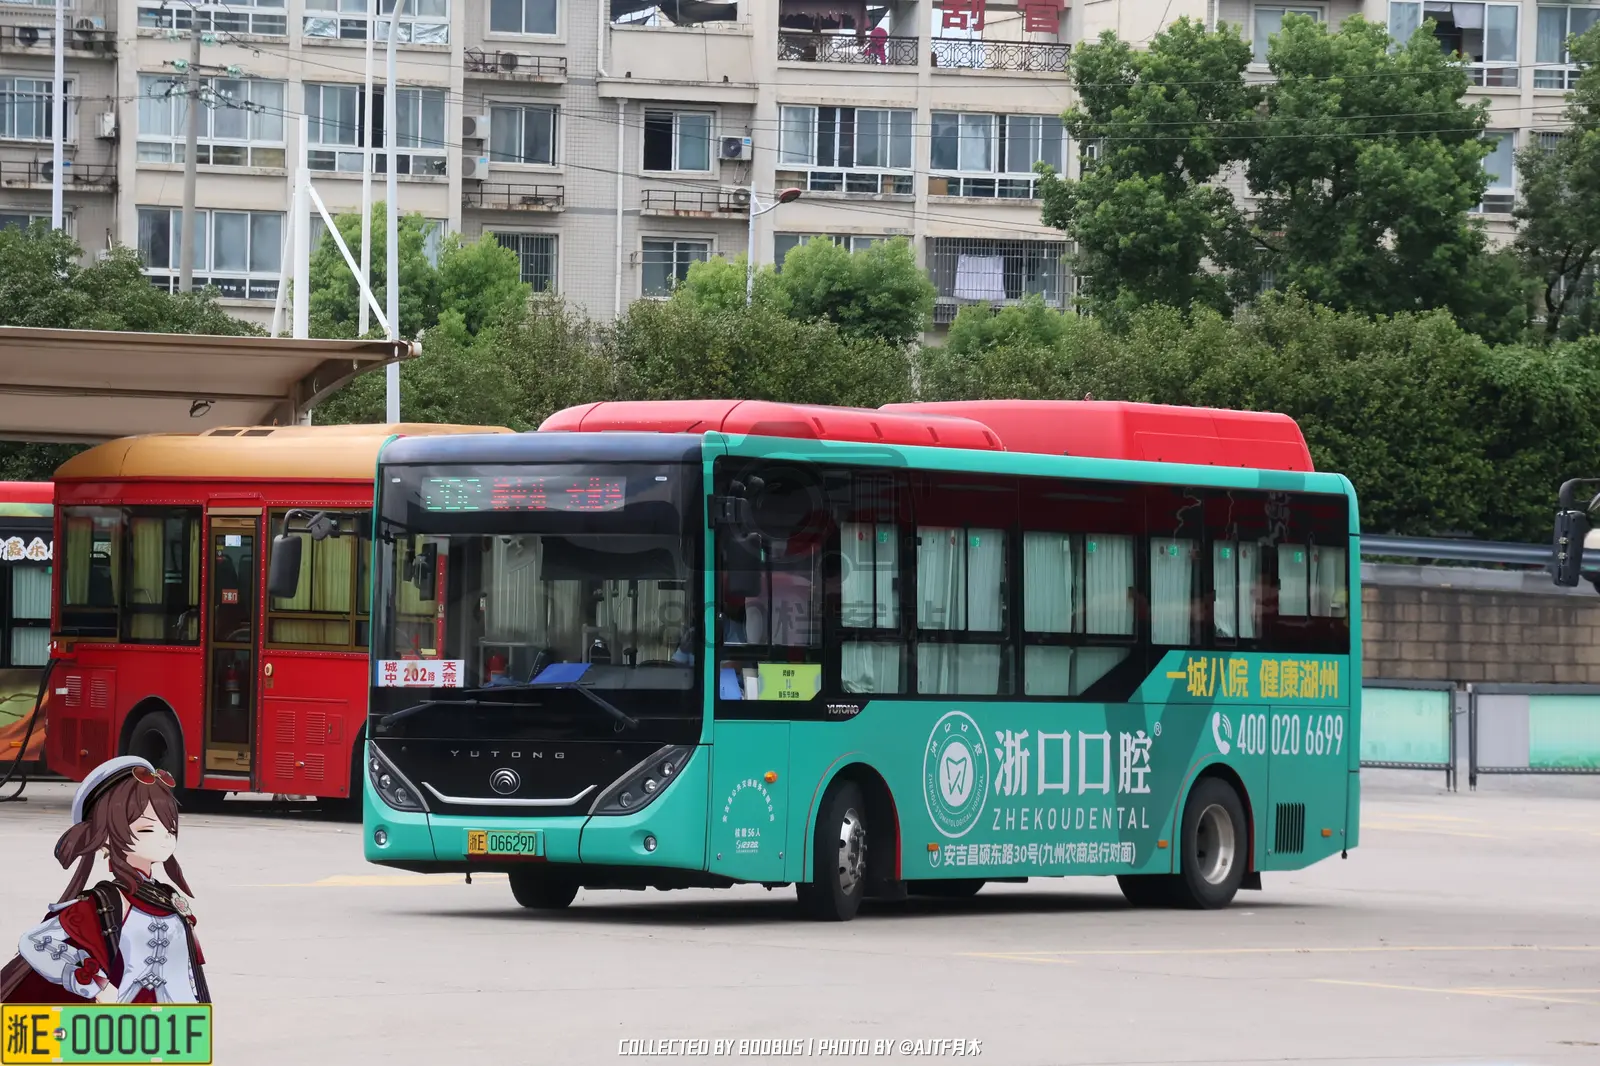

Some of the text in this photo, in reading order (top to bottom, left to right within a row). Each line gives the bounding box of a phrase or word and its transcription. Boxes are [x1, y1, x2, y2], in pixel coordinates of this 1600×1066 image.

[384, 661, 398, 688] 城中
[1166, 656, 1340, 699] 一城八院 健康湖州
[826, 704, 860, 715] YUTONG
[1236, 713, 1344, 756] 400 020 6699
[450, 750, 565, 759] YUTONG
[993, 729, 1153, 796] 浙口口腔
[992, 807, 1150, 831] ZHEKOUDENTAL
[490, 835, 535, 853] 06629D
